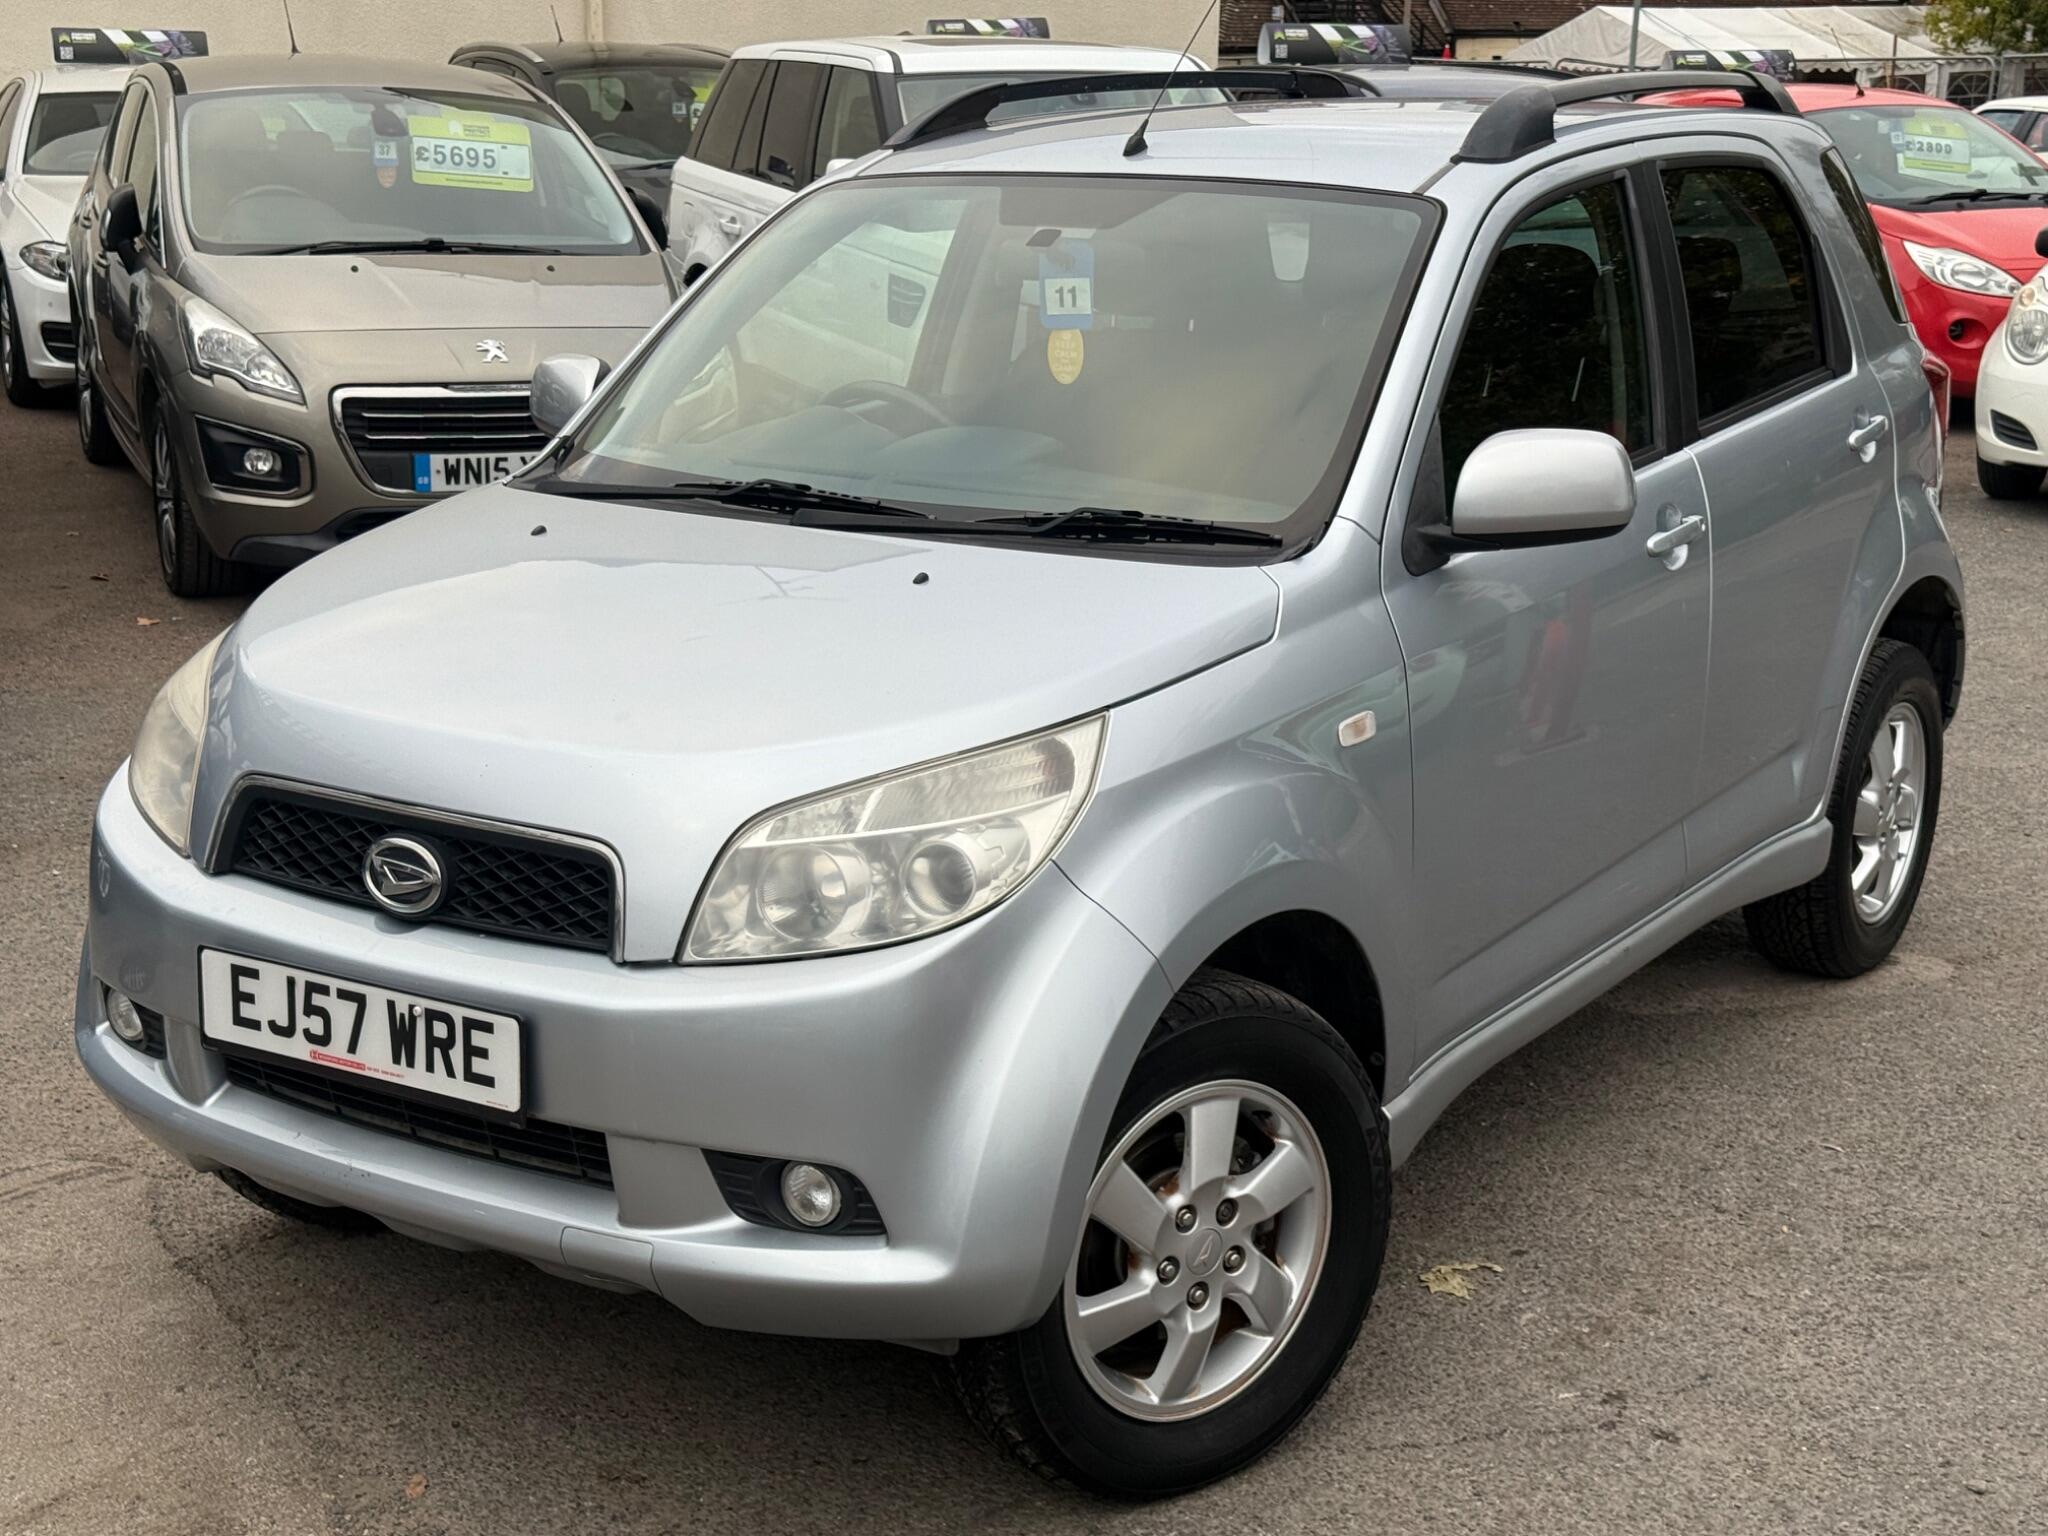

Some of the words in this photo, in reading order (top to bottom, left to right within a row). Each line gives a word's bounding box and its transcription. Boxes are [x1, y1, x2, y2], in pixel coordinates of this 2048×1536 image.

[415, 145, 496, 169] £5695
[1055, 285, 1077, 308] 11
[230, 963, 368, 1055] EJ57
[386, 999, 496, 1089] WRE
